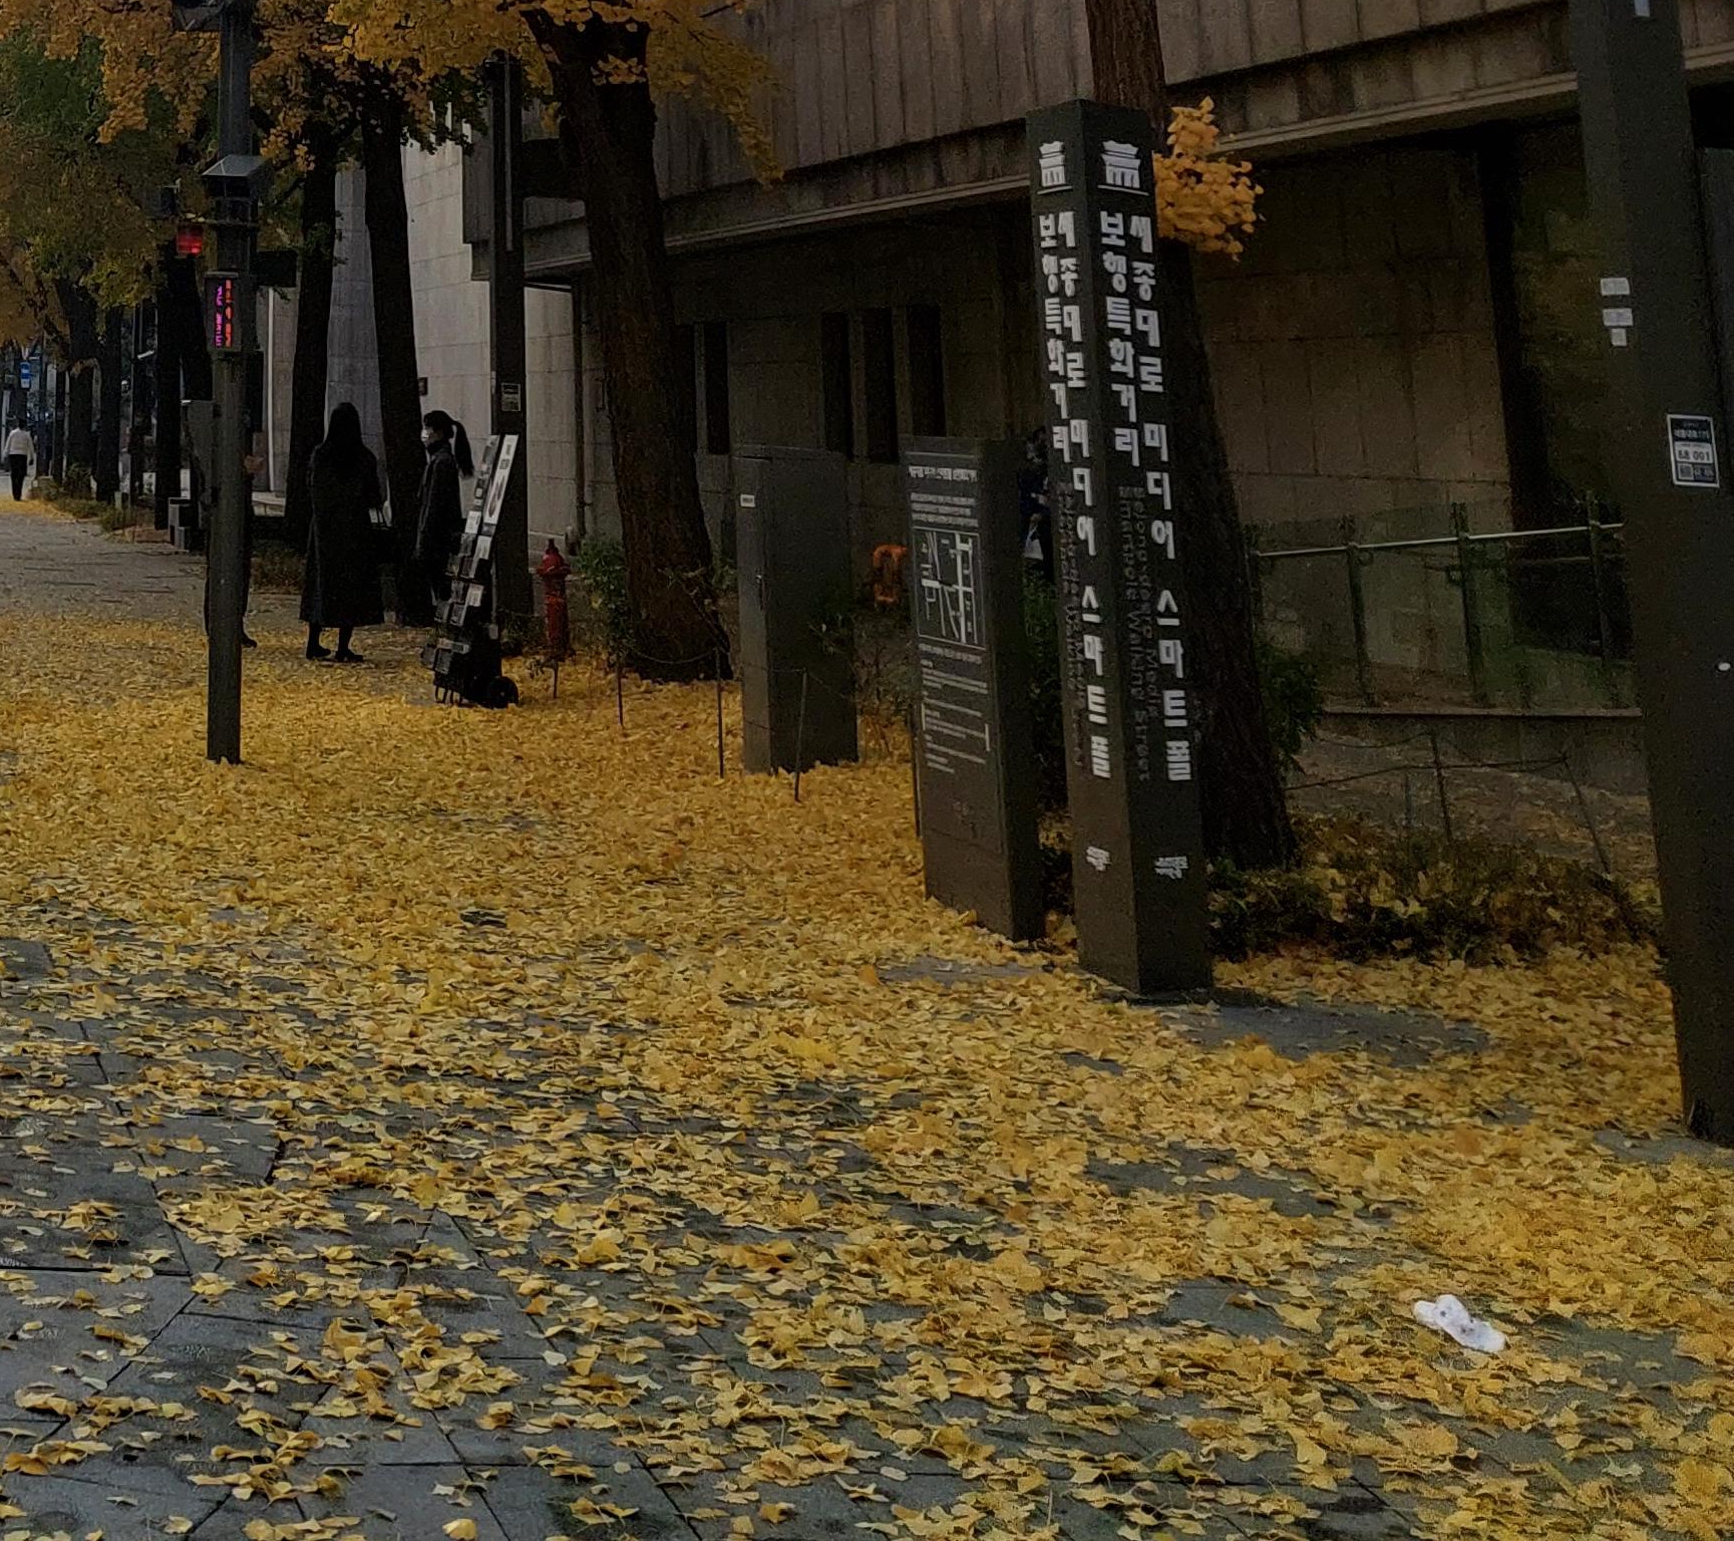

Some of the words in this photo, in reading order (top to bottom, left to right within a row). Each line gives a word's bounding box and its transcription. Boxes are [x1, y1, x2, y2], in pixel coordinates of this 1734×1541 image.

[1038, 213, 1072, 464] 보행특화거리
[1057, 210, 1087, 390] 세종대로
[1099, 210, 1140, 468] 보행특화거리
[1129, 214, 1165, 394] 세종대로
[1069, 418, 1098, 558] 미디어
[1143, 422, 1177, 560] 미디어
[1082, 584, 1112, 780] 스마트폴
[1156, 589, 1193, 782] 스마트폴
